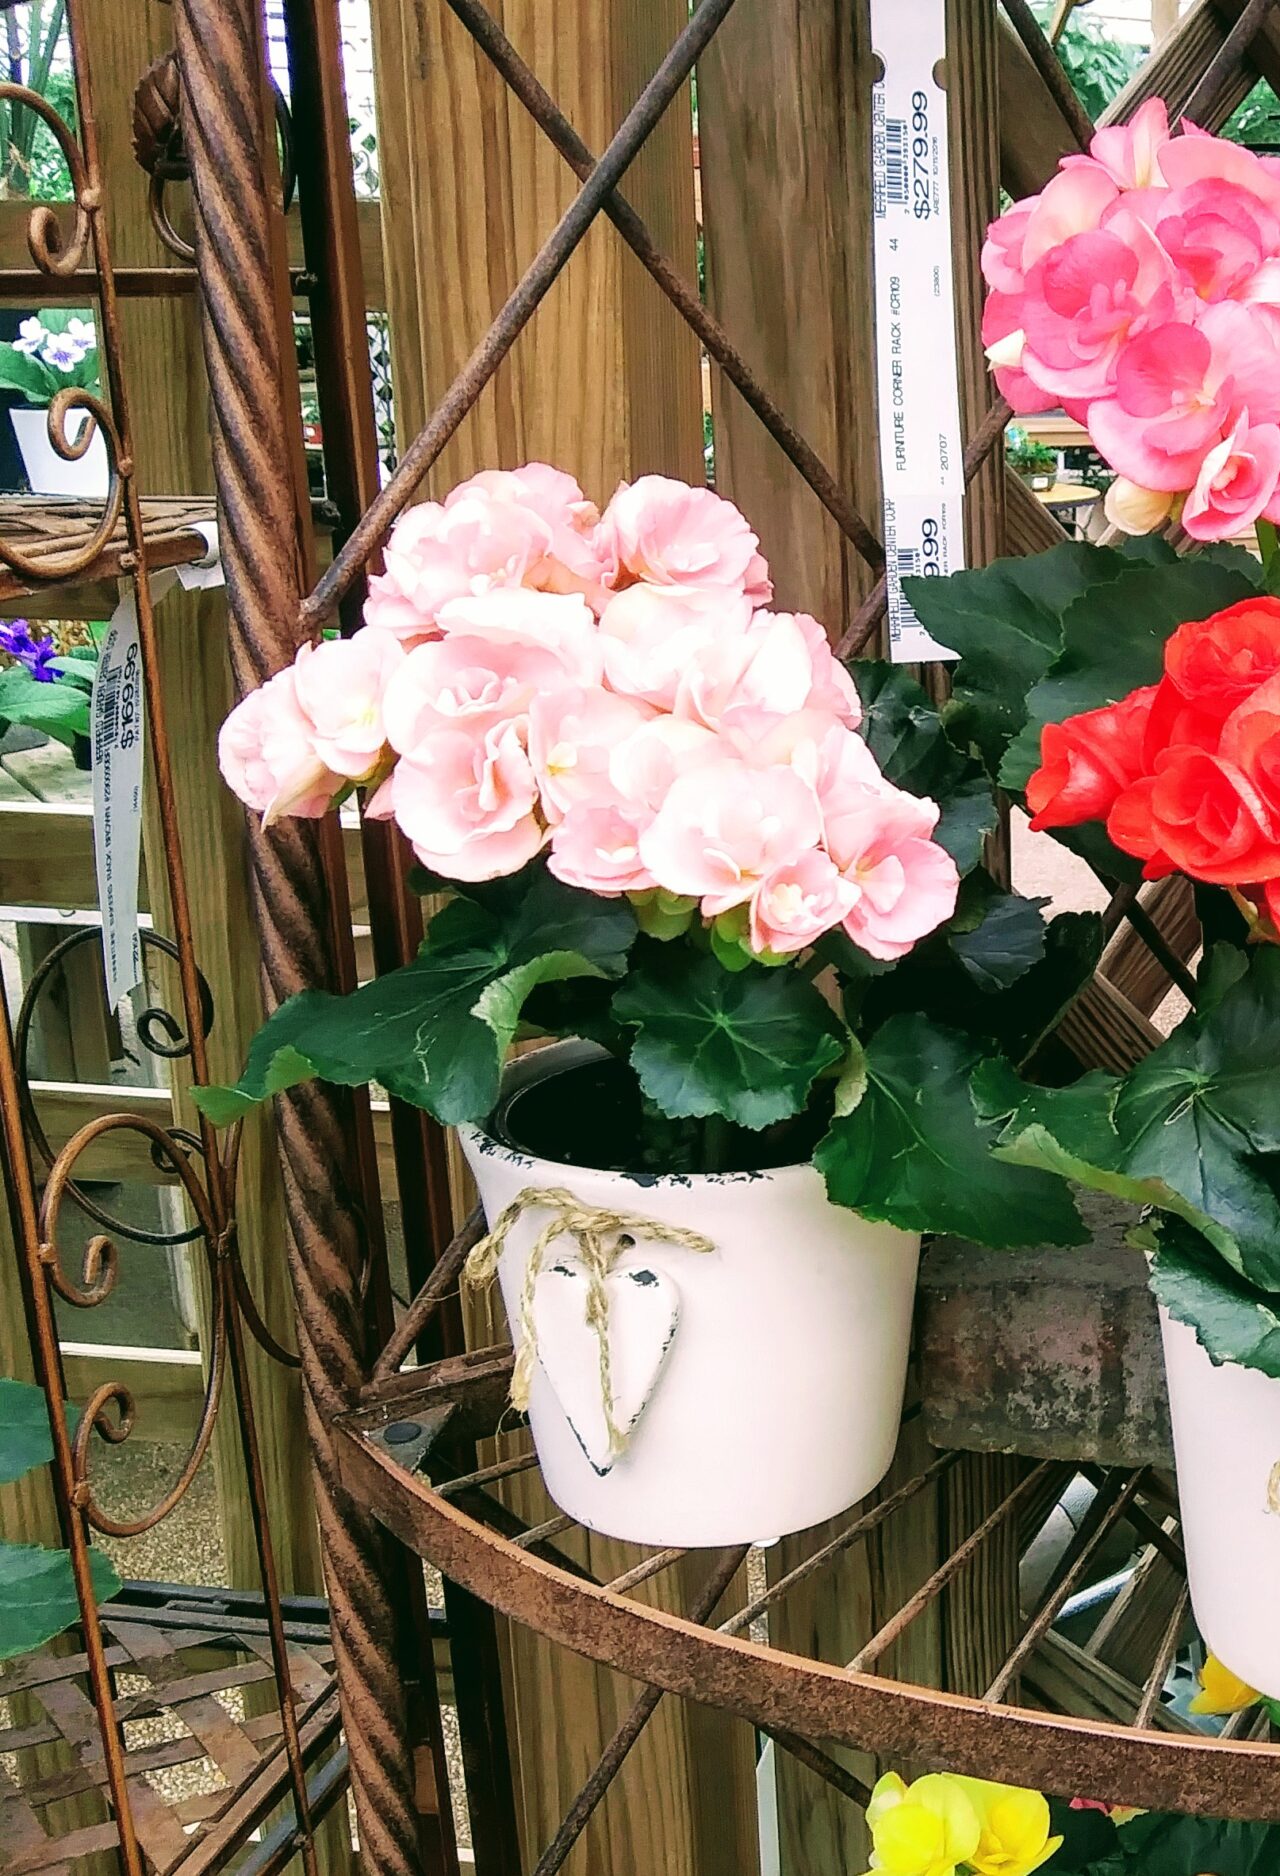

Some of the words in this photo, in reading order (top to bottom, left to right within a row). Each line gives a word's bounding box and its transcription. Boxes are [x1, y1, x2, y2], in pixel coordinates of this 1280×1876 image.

[874, 93, 886, 128] CENTER
[874, 130, 887, 167] GARDEN
[911, 90, 932, 220] $279.99
[874, 171, 887, 219] MERRIFIELD
[888, 238, 899, 252] 44
[889, 276, 901, 316] #CR109
[890, 321, 902, 355] RACK
[891, 359, 905, 406] CORNER
[893, 411, 907, 471] FURNITURE
[938, 433, 949, 471] 20707
[885, 498, 897, 522] CORP
[885, 524, 898, 557] CENTER
[921, 518, 940, 577] 9.99
[887, 560, 899, 594] GARDEN
[914, 552, 922, 574] 3150
[890, 597, 902, 642] MERRIFIELD
[119, 642, 138, 750] $169.99
